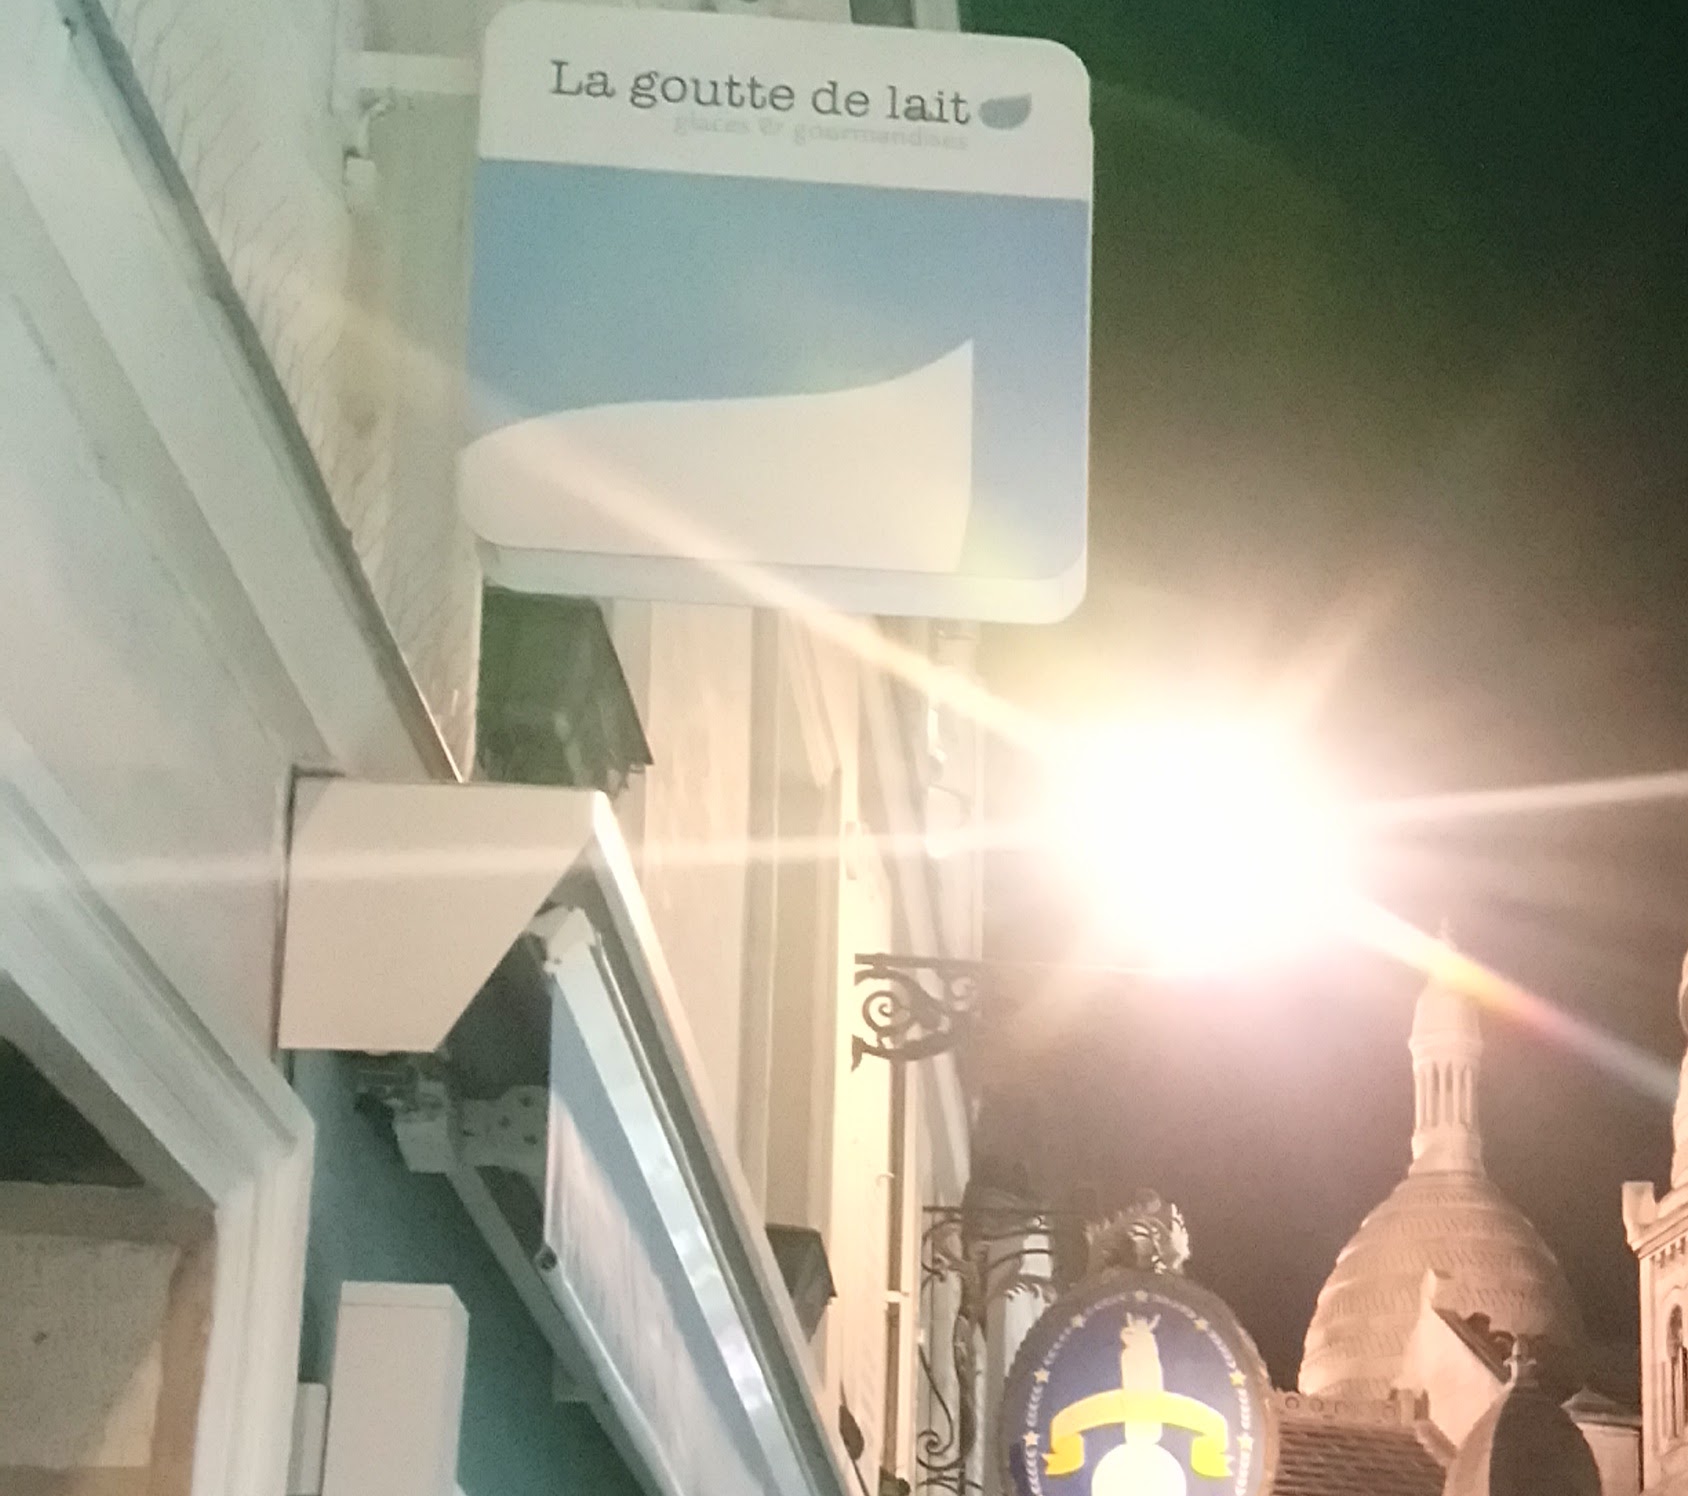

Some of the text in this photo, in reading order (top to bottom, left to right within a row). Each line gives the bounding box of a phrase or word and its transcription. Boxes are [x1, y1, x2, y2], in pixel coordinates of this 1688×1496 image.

[549, 59, 970, 125] La goutte de lait
